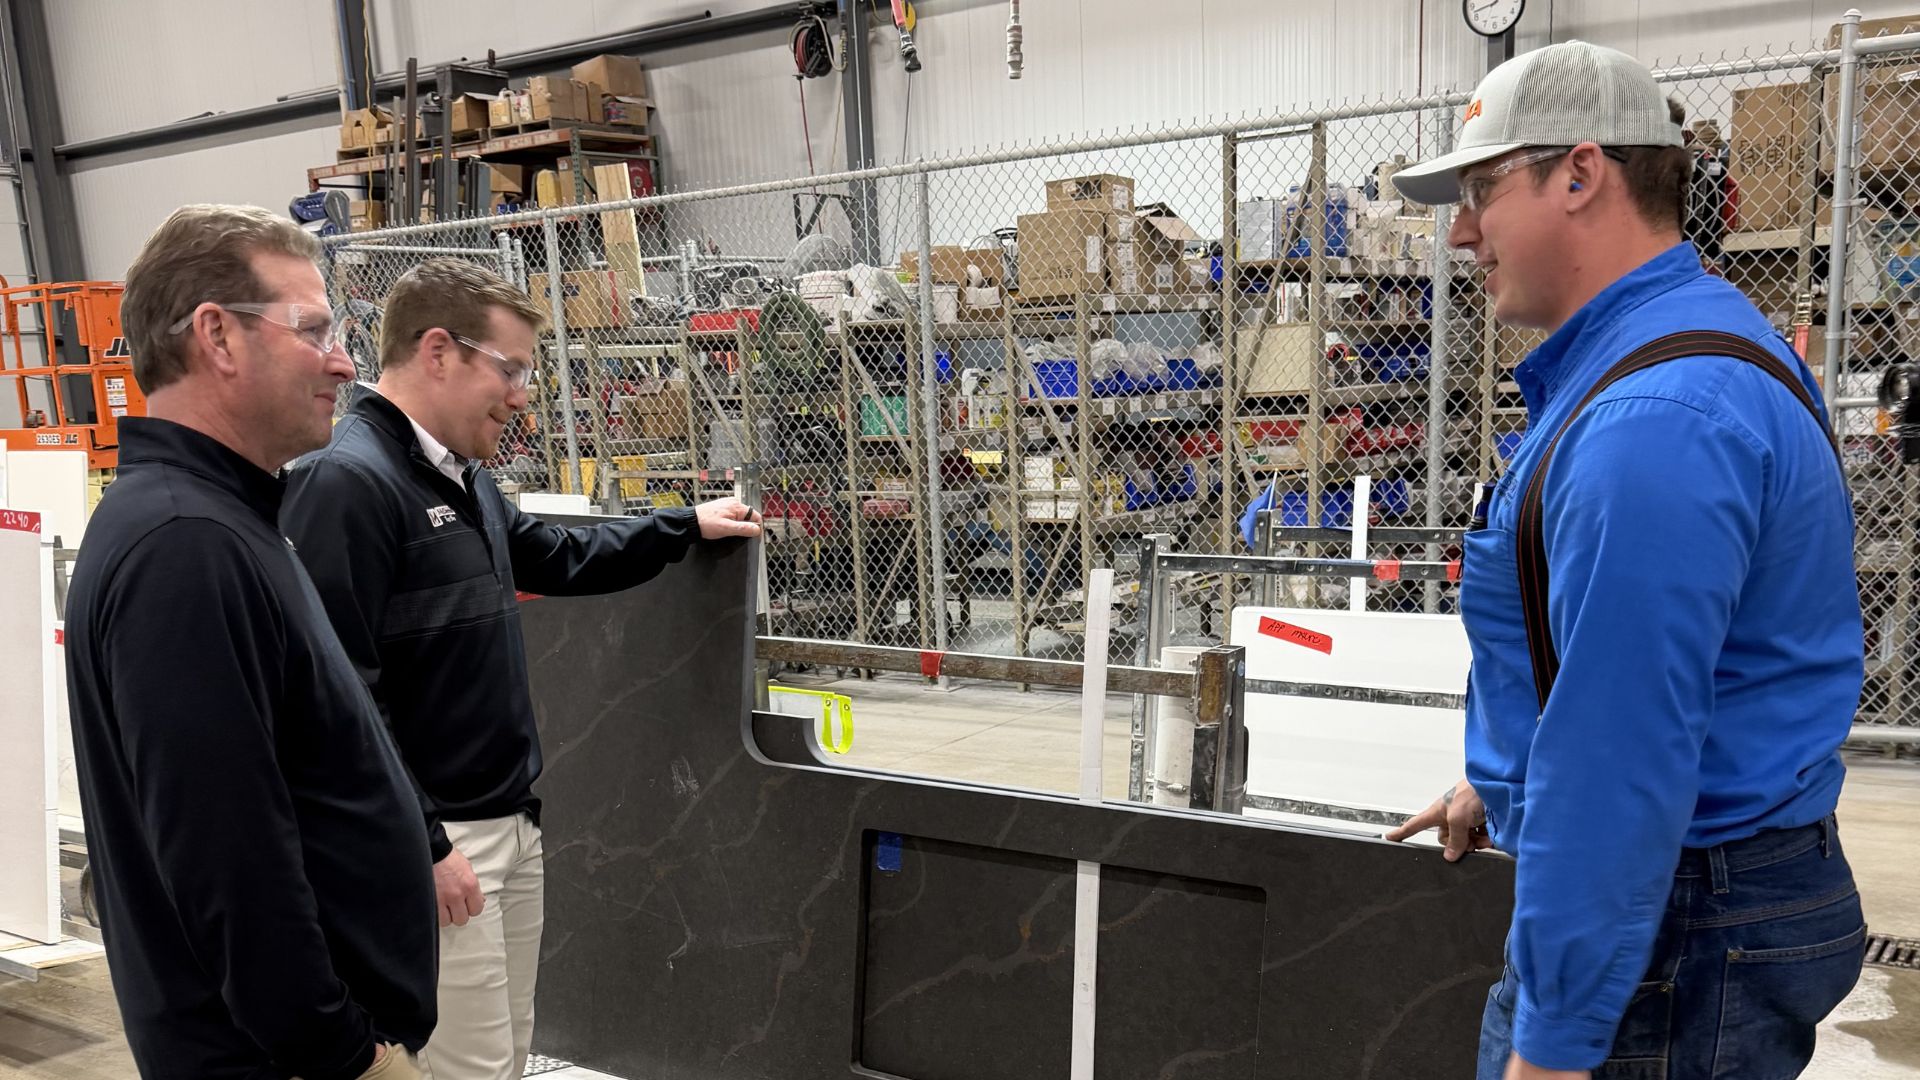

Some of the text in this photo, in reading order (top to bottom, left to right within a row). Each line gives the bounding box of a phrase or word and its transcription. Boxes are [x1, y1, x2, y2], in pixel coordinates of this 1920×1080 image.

[1469, 3, 1475, 11] 9
[1510, 7, 1515, 15] 4
[1473, 13, 1479, 21] 8
[1502, 16, 1508, 25] 5
[1482, 20, 1488, 28] 7
[1492, 21, 1498, 29] 6
[104, 337, 131, 357] JL
